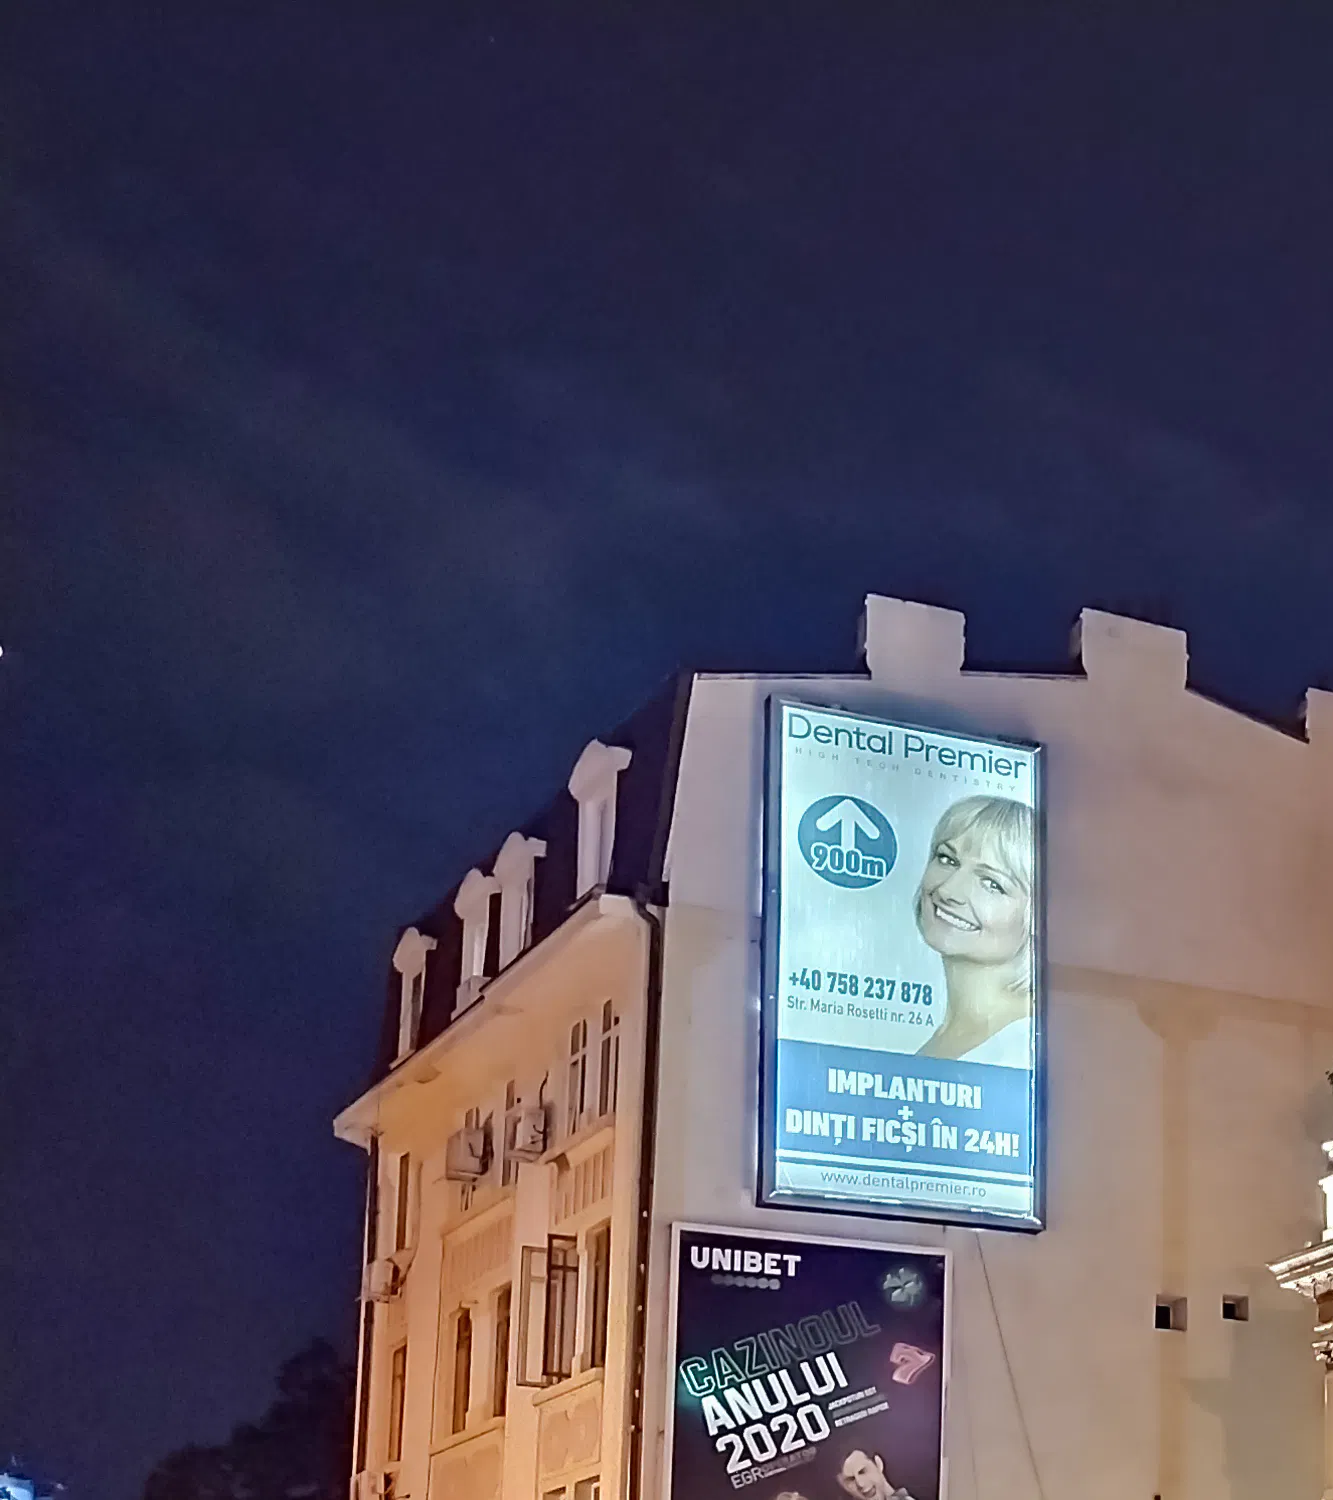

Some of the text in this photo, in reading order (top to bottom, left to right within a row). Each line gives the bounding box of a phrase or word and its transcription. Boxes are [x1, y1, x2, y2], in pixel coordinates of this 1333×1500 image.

[788, 713, 1027, 779] Dental Premier
[811, 842, 887, 880] 900m
[788, 968, 933, 1006] +40 758 237 878
[787, 995, 935, 1027] Str. Maria Rosetti nr. 26 A
[828, 1067, 982, 1110] IMPLANTURI
[785, 1108, 1020, 1158] DINȚI FICȘI ÎN 24H!
[820, 1171, 987, 1198] www.dentalpremier.ro
[690, 1246, 802, 1277] UNIBET
[679, 1301, 882, 1397] CAZINOUL
[701, 1351, 848, 1436] ANULUI
[715, 1403, 831, 1474] 2020
